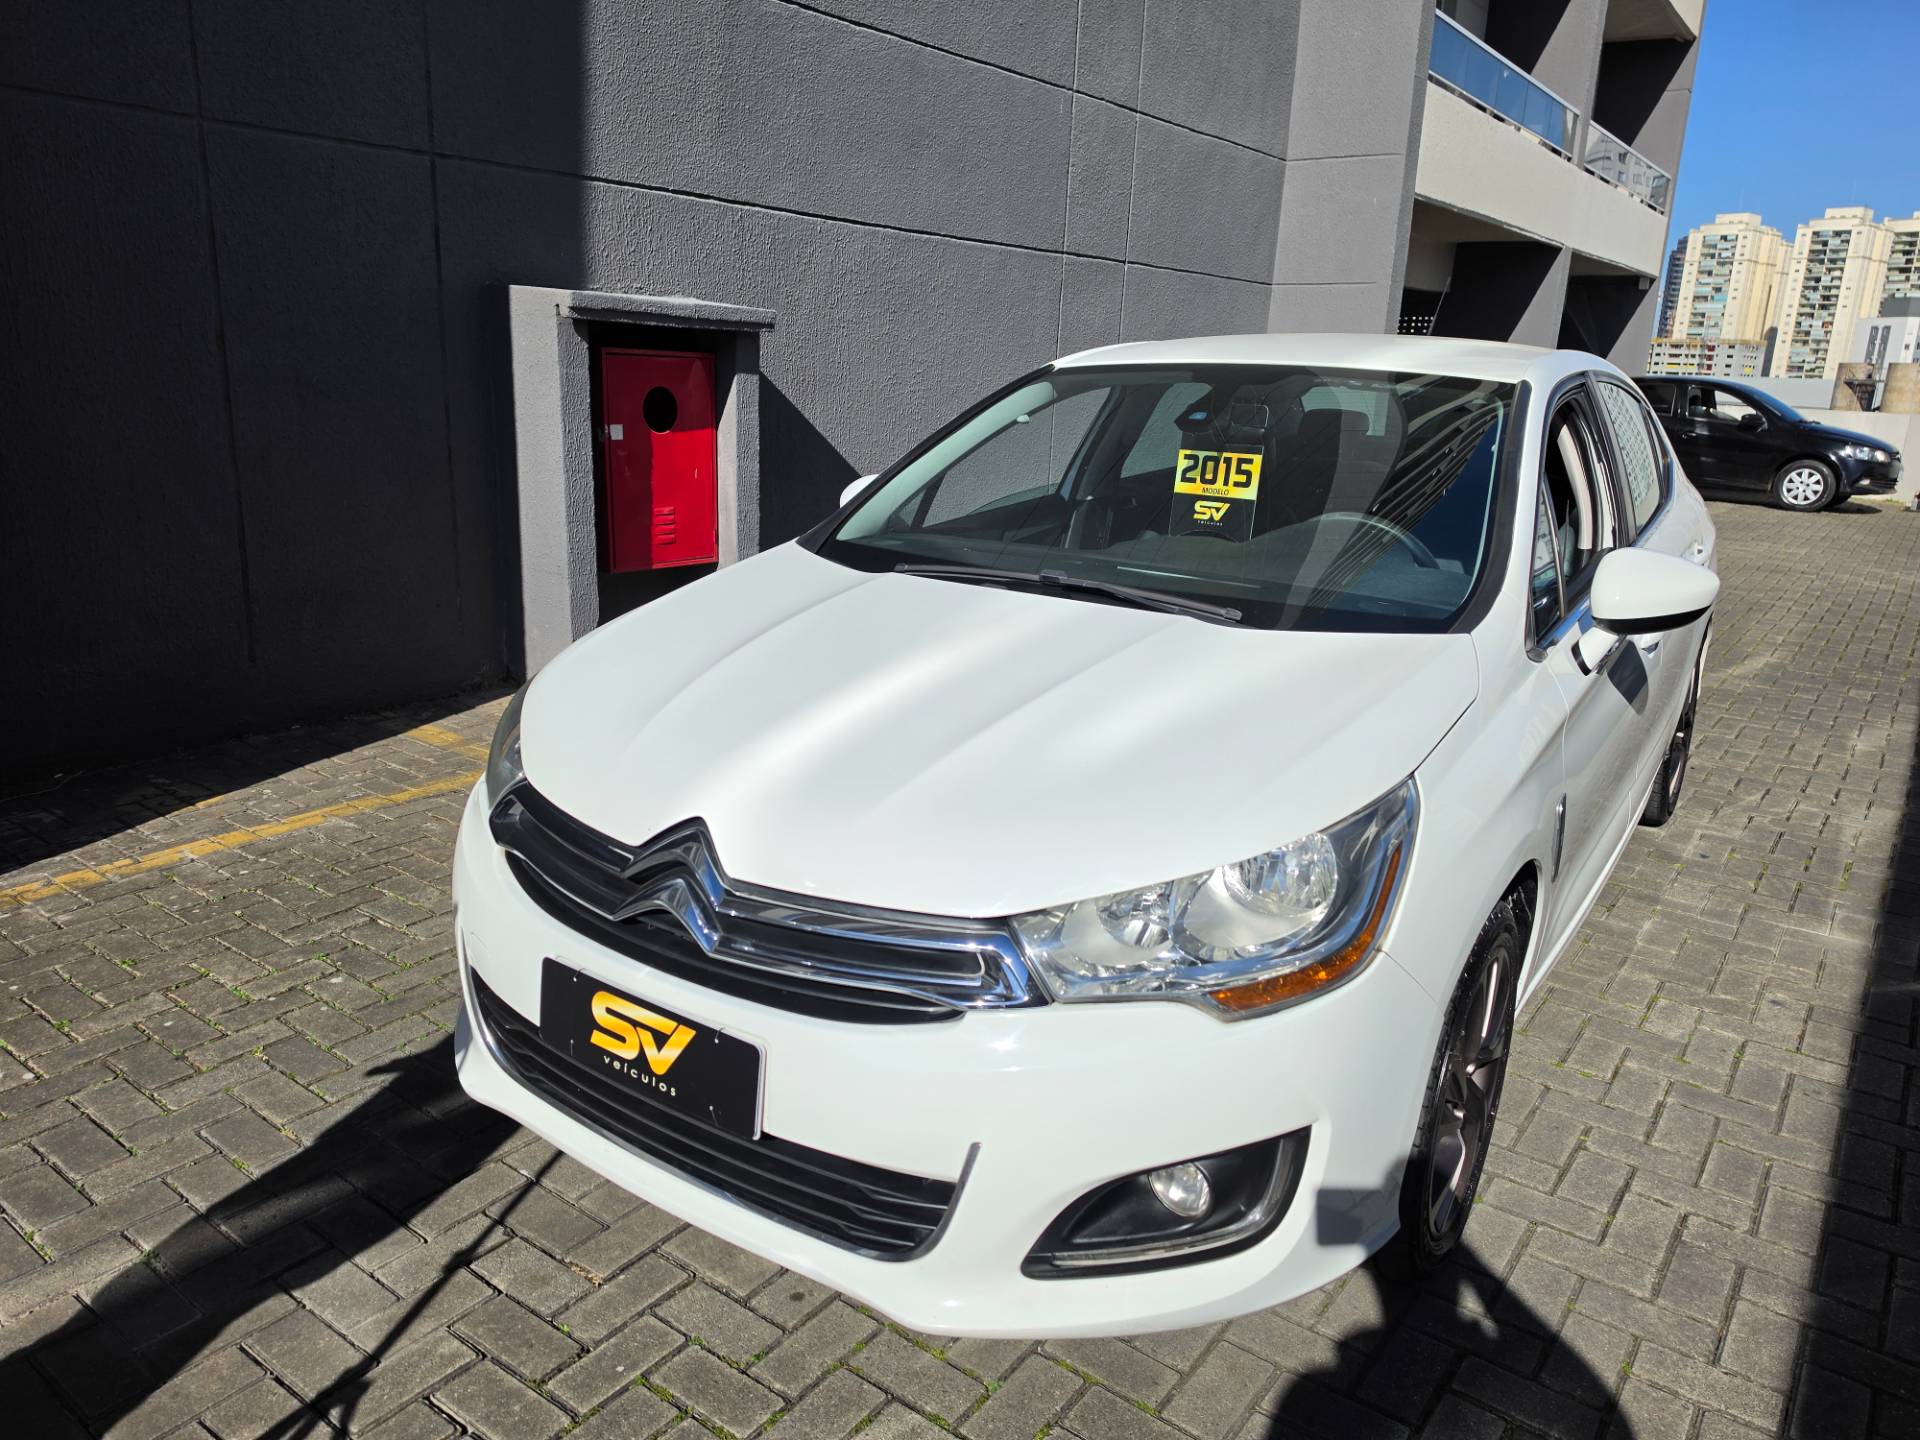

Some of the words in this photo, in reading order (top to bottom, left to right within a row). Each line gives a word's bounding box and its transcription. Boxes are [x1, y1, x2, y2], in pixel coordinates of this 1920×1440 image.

[1181, 454, 1254, 488] 2015
[1202, 487, 1230, 496] MODELO
[1193, 500, 1231, 521] SV
[590, 991, 697, 1075] SV
[603, 1055, 677, 1096] veiculos
